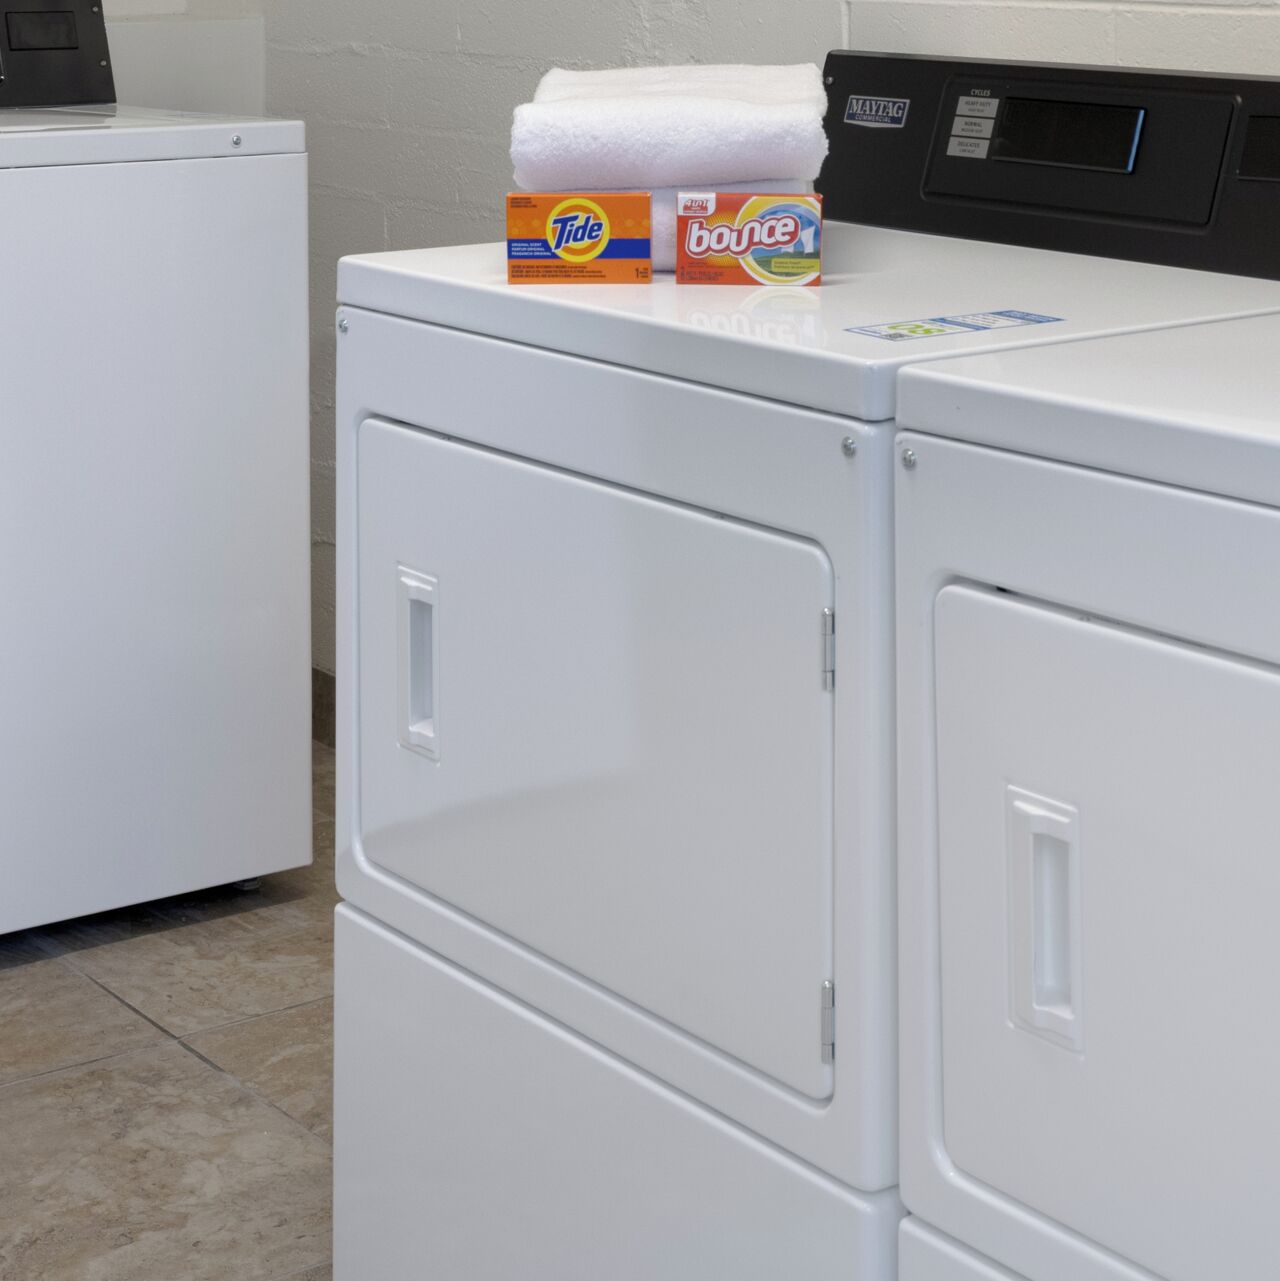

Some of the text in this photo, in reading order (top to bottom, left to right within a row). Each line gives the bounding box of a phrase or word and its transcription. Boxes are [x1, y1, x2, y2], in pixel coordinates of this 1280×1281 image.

[970, 89, 991, 97] CYCLES
[849, 99, 905, 118] MAYTAG
[855, 114, 892, 123] COMMERCIAL
[551, 214, 604, 253] Tide
[687, 216, 797, 254] bounce
[635, 268, 640, 279] 1
